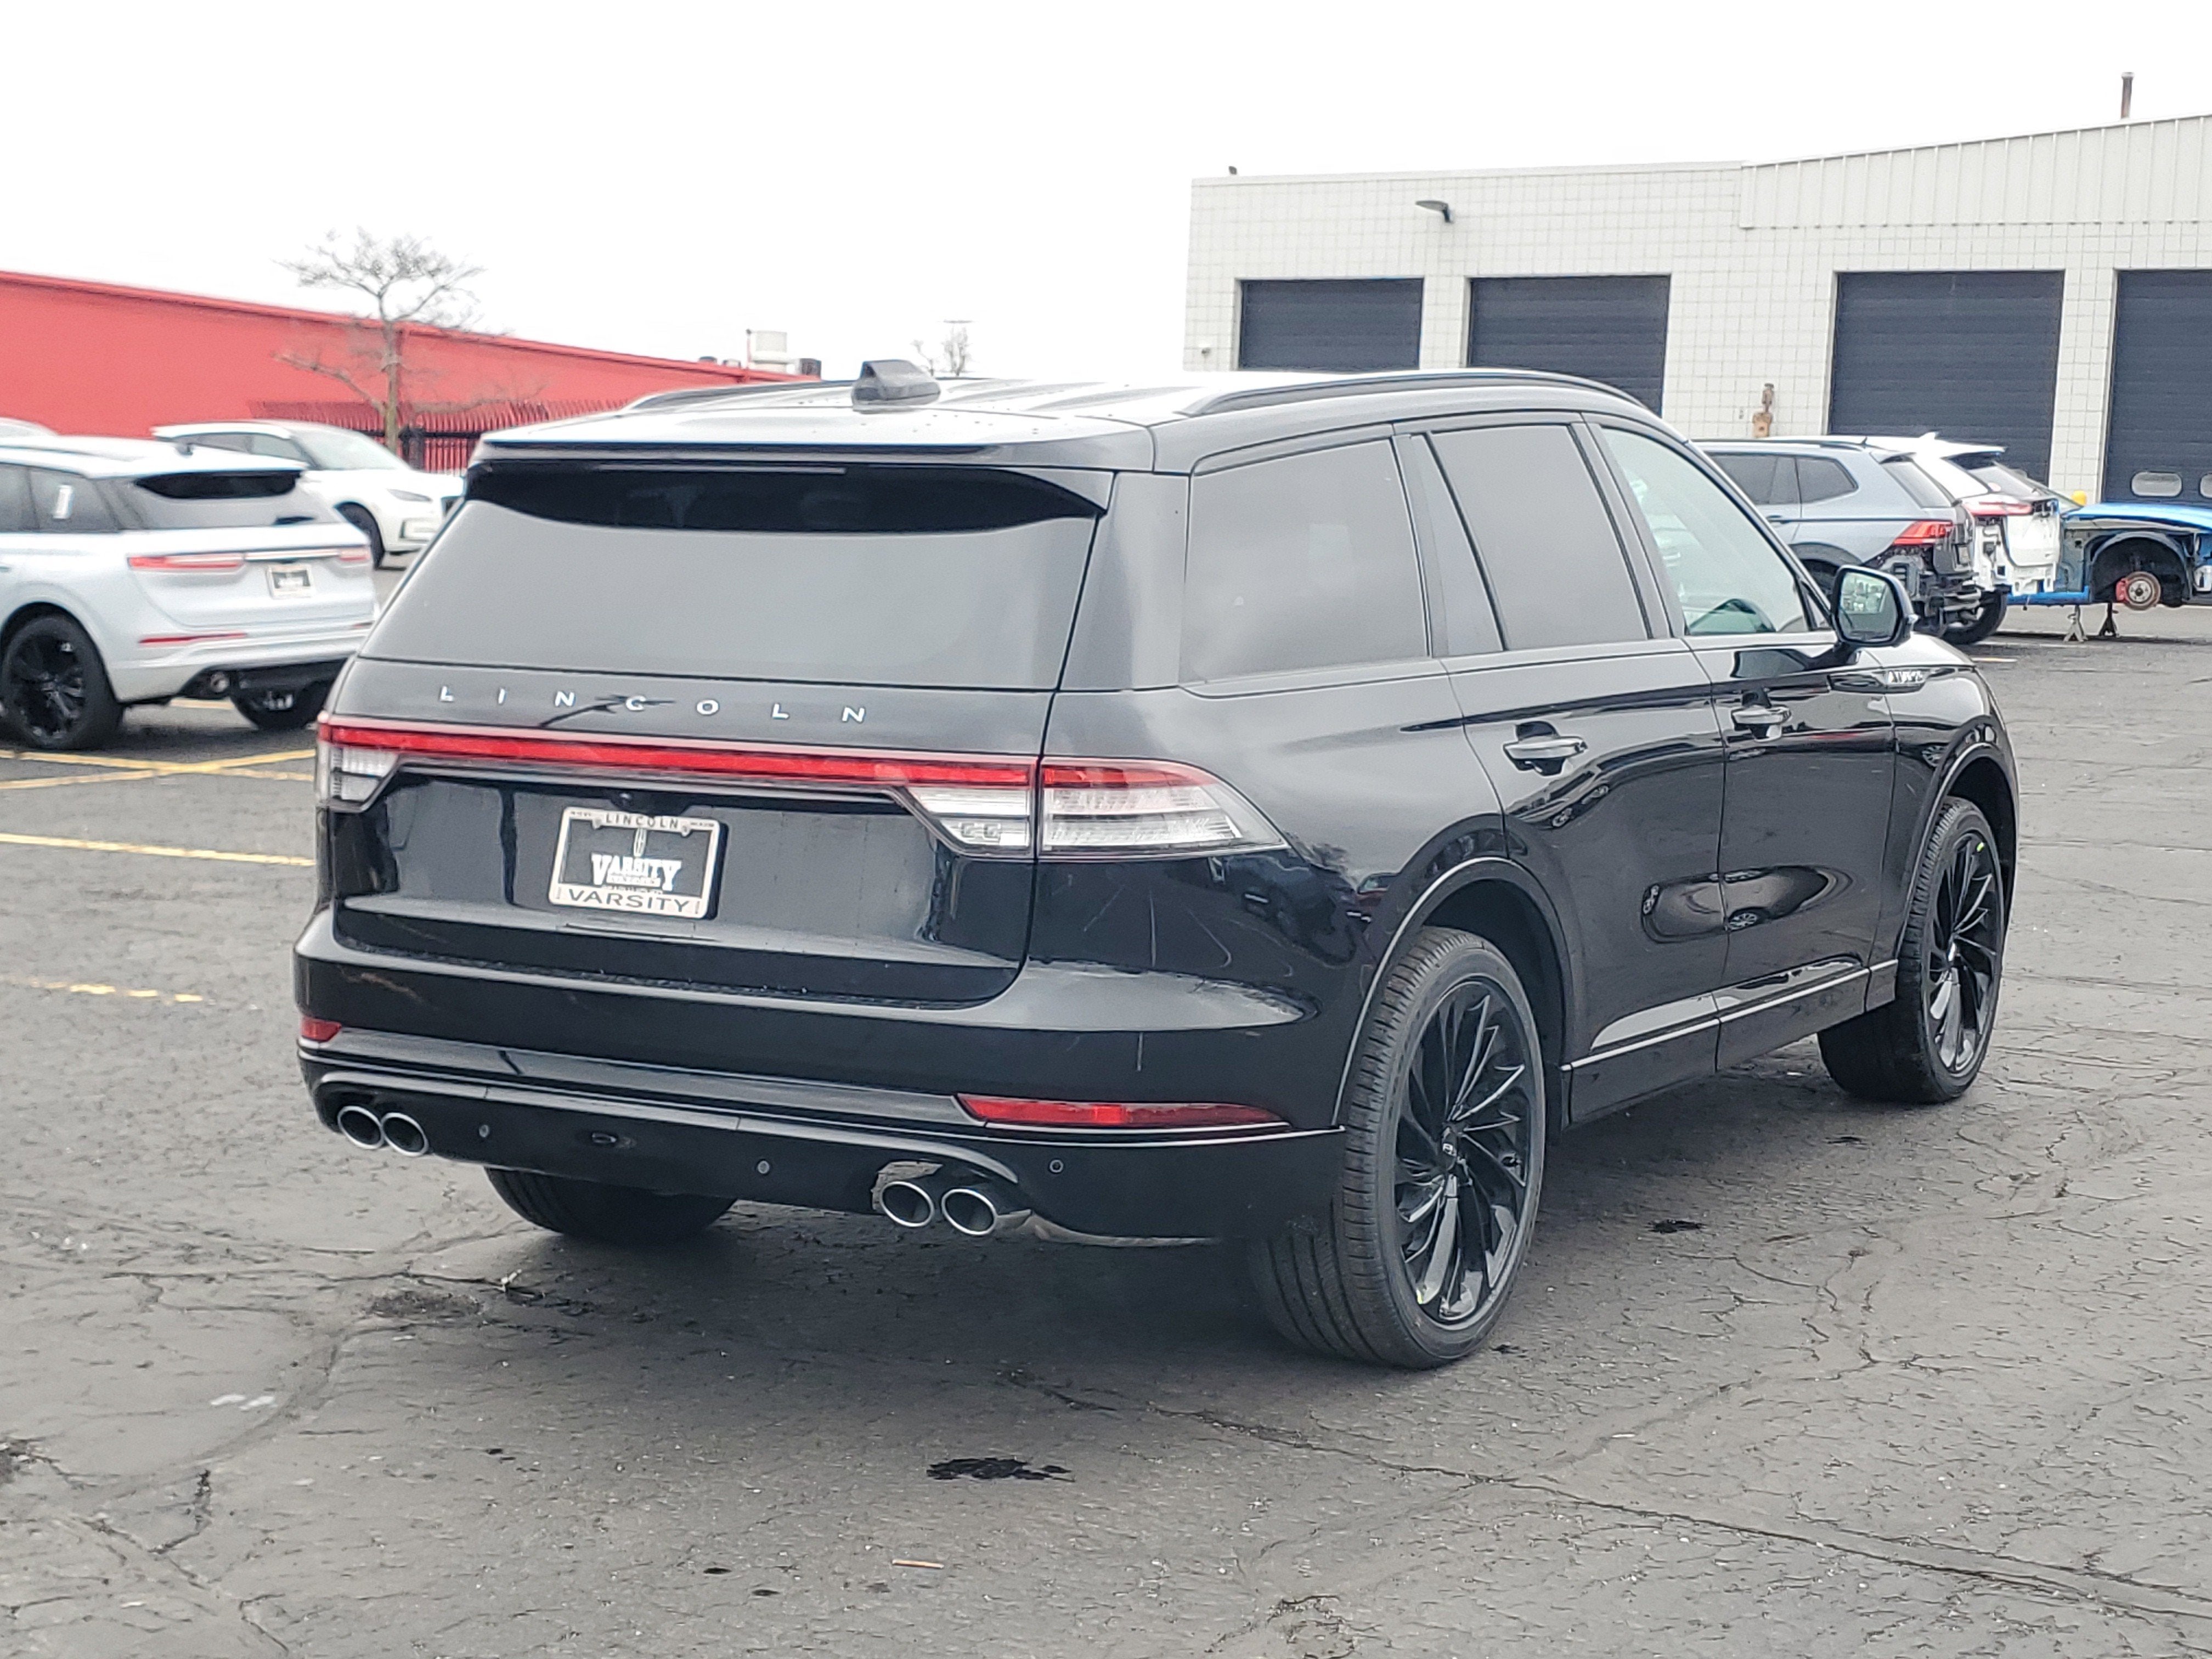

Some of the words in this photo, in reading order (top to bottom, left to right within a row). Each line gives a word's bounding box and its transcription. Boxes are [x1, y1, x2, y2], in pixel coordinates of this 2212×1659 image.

[439, 686, 866, 723] LINCOLN
[606, 814, 679, 829] LINCOLN
[591, 853, 682, 890] VARSITY
[569, 888, 690, 912] VARSITY
